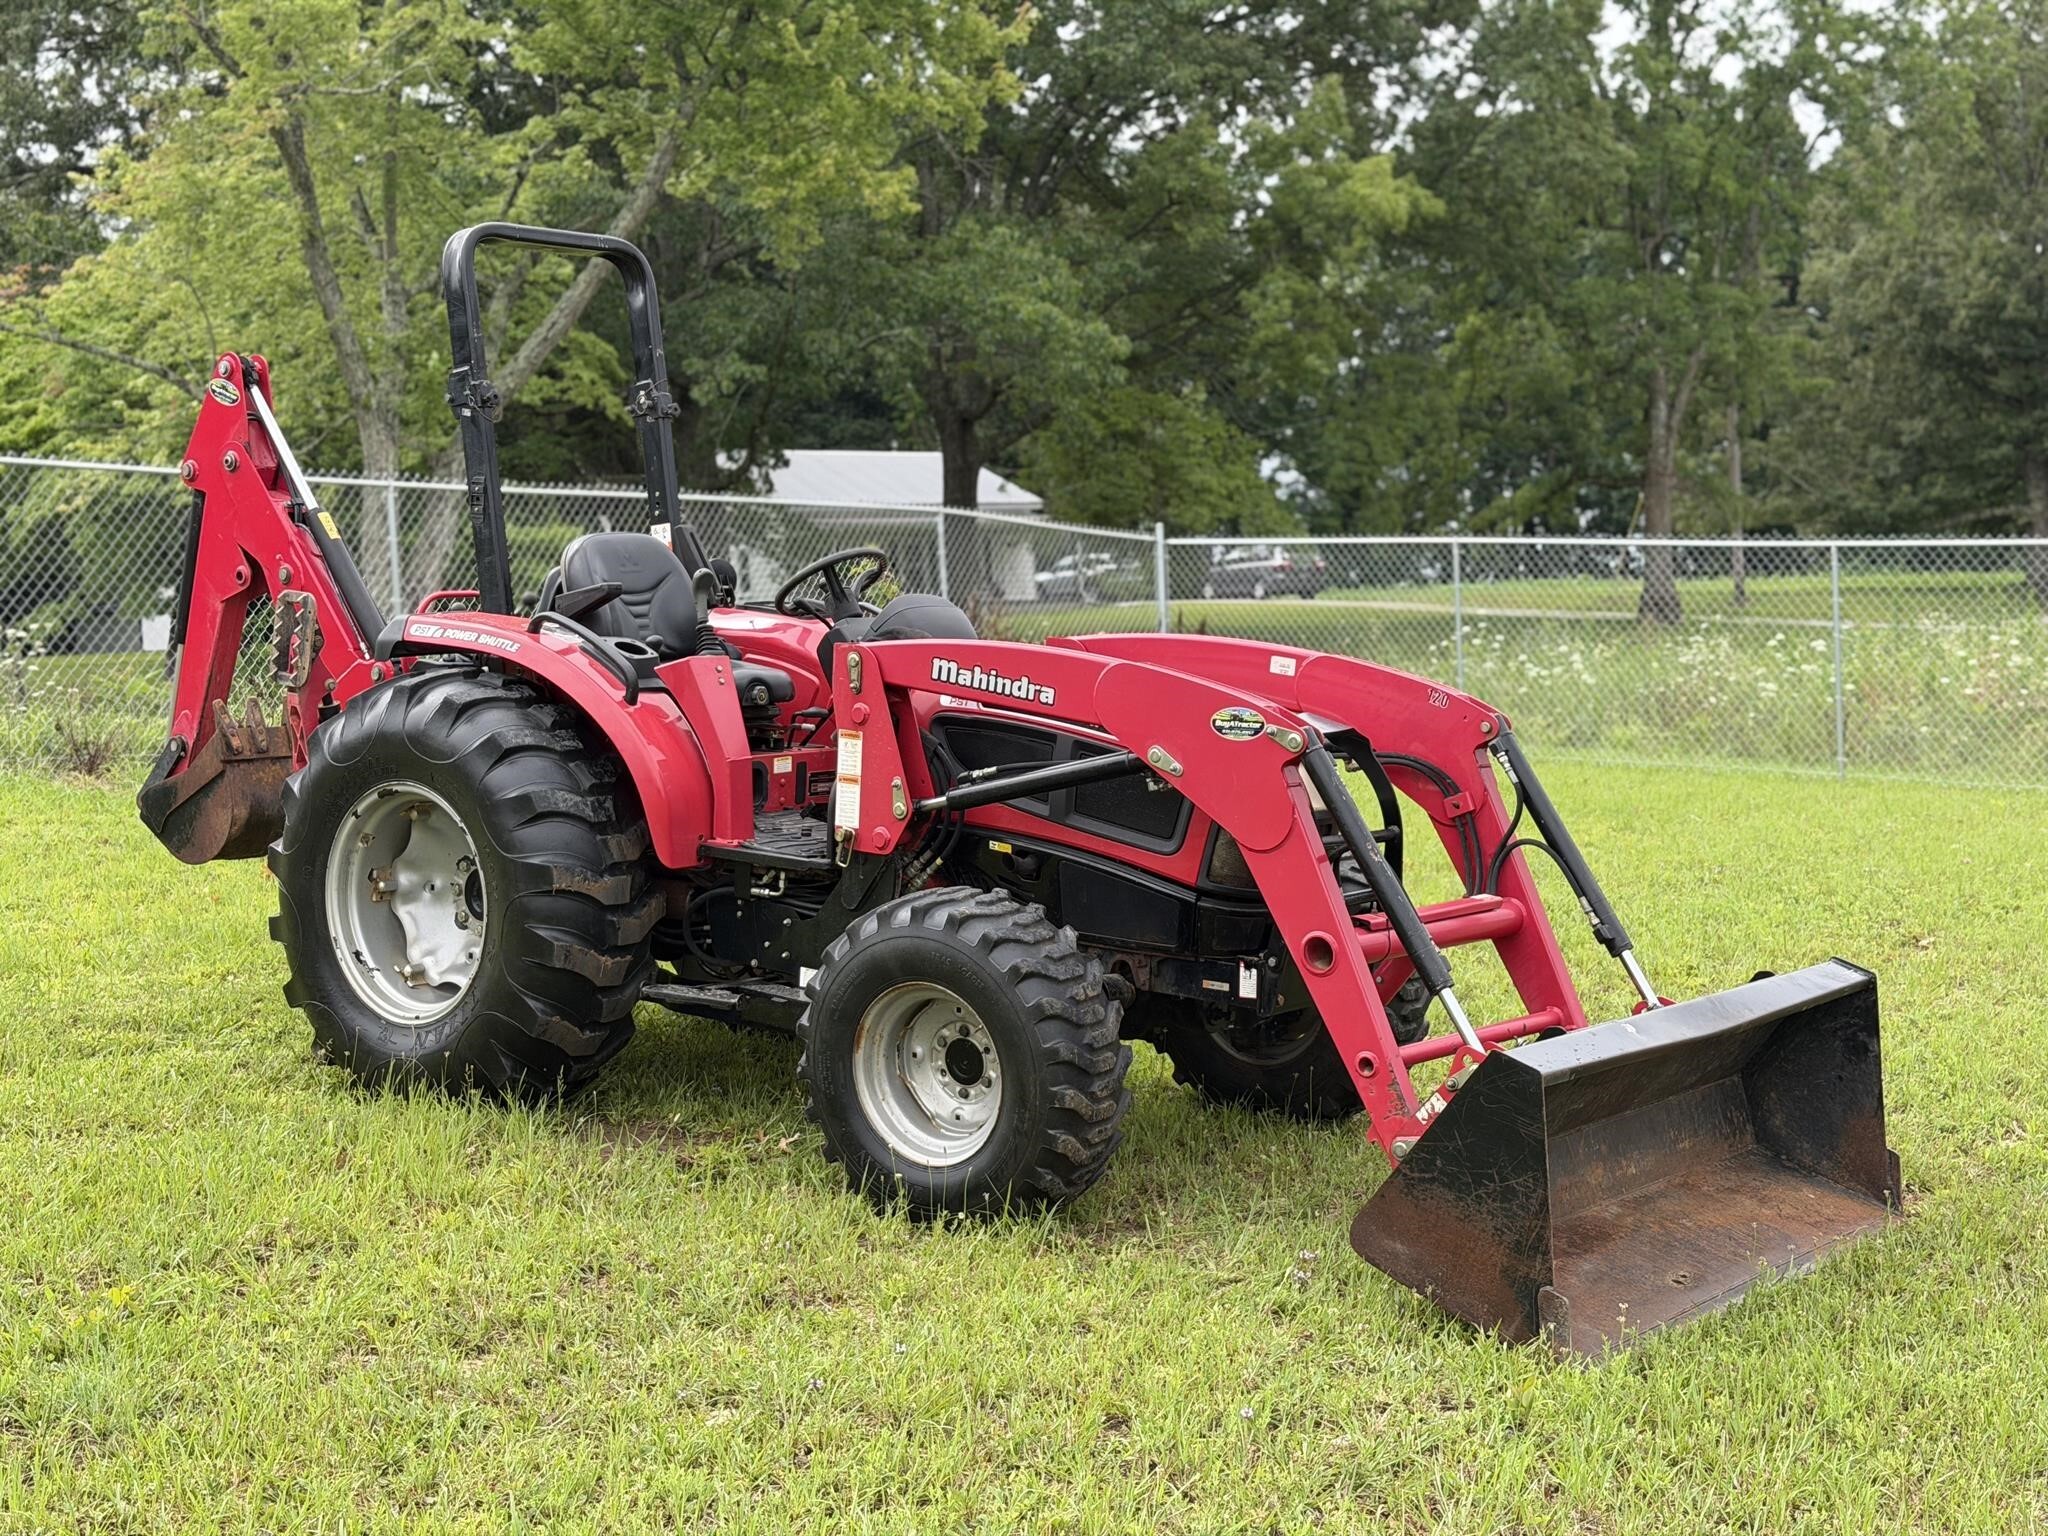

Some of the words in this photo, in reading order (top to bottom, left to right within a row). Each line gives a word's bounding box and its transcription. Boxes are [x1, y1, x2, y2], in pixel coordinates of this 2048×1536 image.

[443, 628, 478, 641] POWER
[478, 634, 520, 652] SHUTTLE
[931, 656, 1056, 706] Mahindra
[1427, 687, 1450, 709] 120
